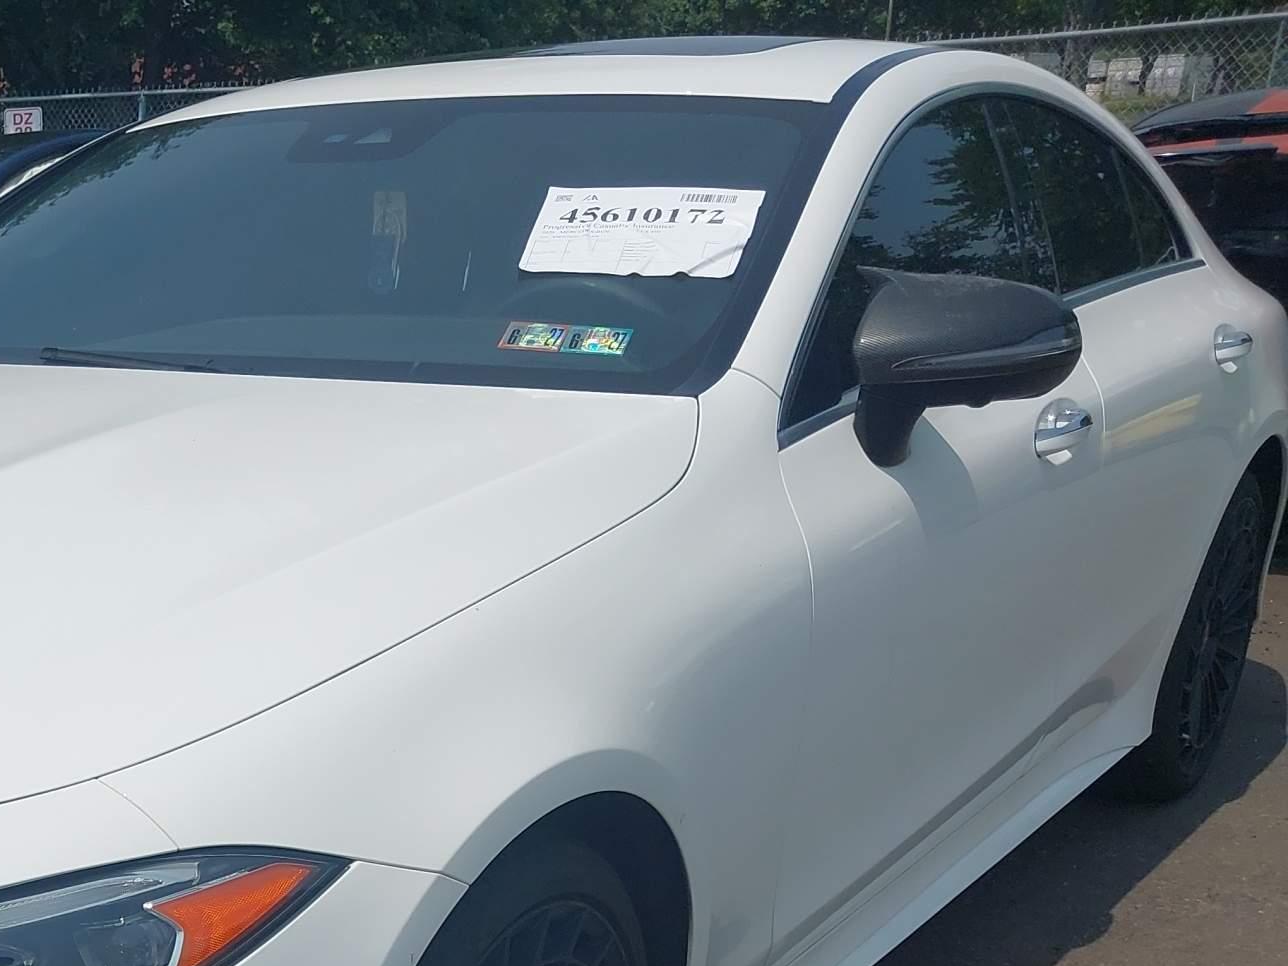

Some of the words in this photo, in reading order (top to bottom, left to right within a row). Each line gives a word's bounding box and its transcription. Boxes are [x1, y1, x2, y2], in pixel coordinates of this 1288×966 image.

[13, 112, 33, 125] DZ
[559, 206, 726, 225] 45610172
[544, 327, 564, 347] 27
[608, 331, 627, 351] 27
